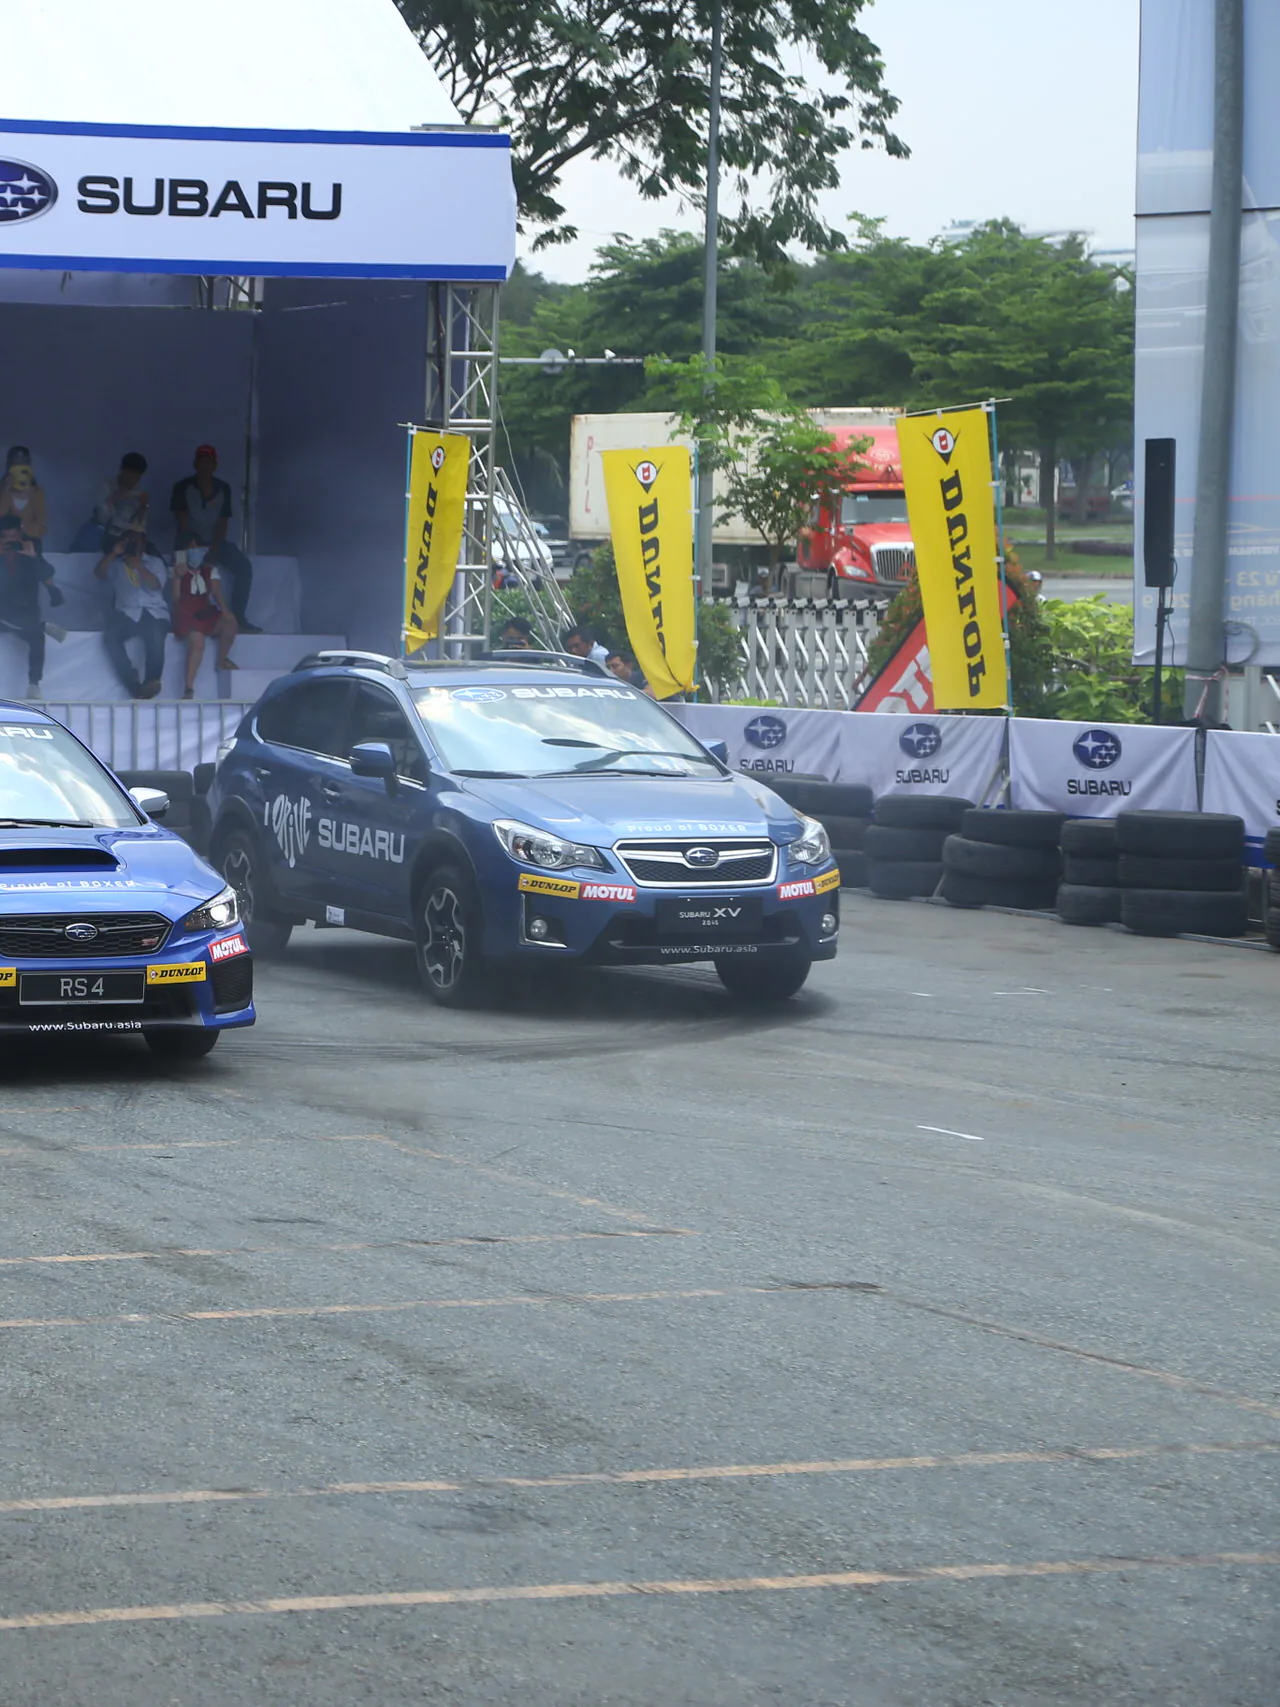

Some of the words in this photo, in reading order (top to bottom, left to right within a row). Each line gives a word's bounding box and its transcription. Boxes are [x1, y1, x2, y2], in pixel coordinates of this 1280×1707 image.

[77, 175, 342, 220] SUBARU
[410, 482, 439, 631] DUNL
[638, 497, 666, 659] DUNL
[940, 469, 986, 697] DUNLOP
[512, 687, 637, 701] SUBARU
[740, 758, 795, 773] SUBARU
[895, 769, 950, 784] SUBARU
[1067, 779, 1132, 796] SUBARU
[318, 818, 405, 864] SUBARU
[530, 879, 577, 893] DUNLOP
[583, 885, 635, 900] MOTUL
[780, 881, 814, 899] MOTUL
[713, 907, 742, 918] XV
[212, 937, 245, 960] MOTUL
[660, 945, 758, 954] www.Subaru.asia
[159, 967, 204, 978] DUNLOP
[60, 978, 88, 997] RS
[91, 977, 104, 996] 4
[28, 1020, 142, 1032] www.Subaru.asia
